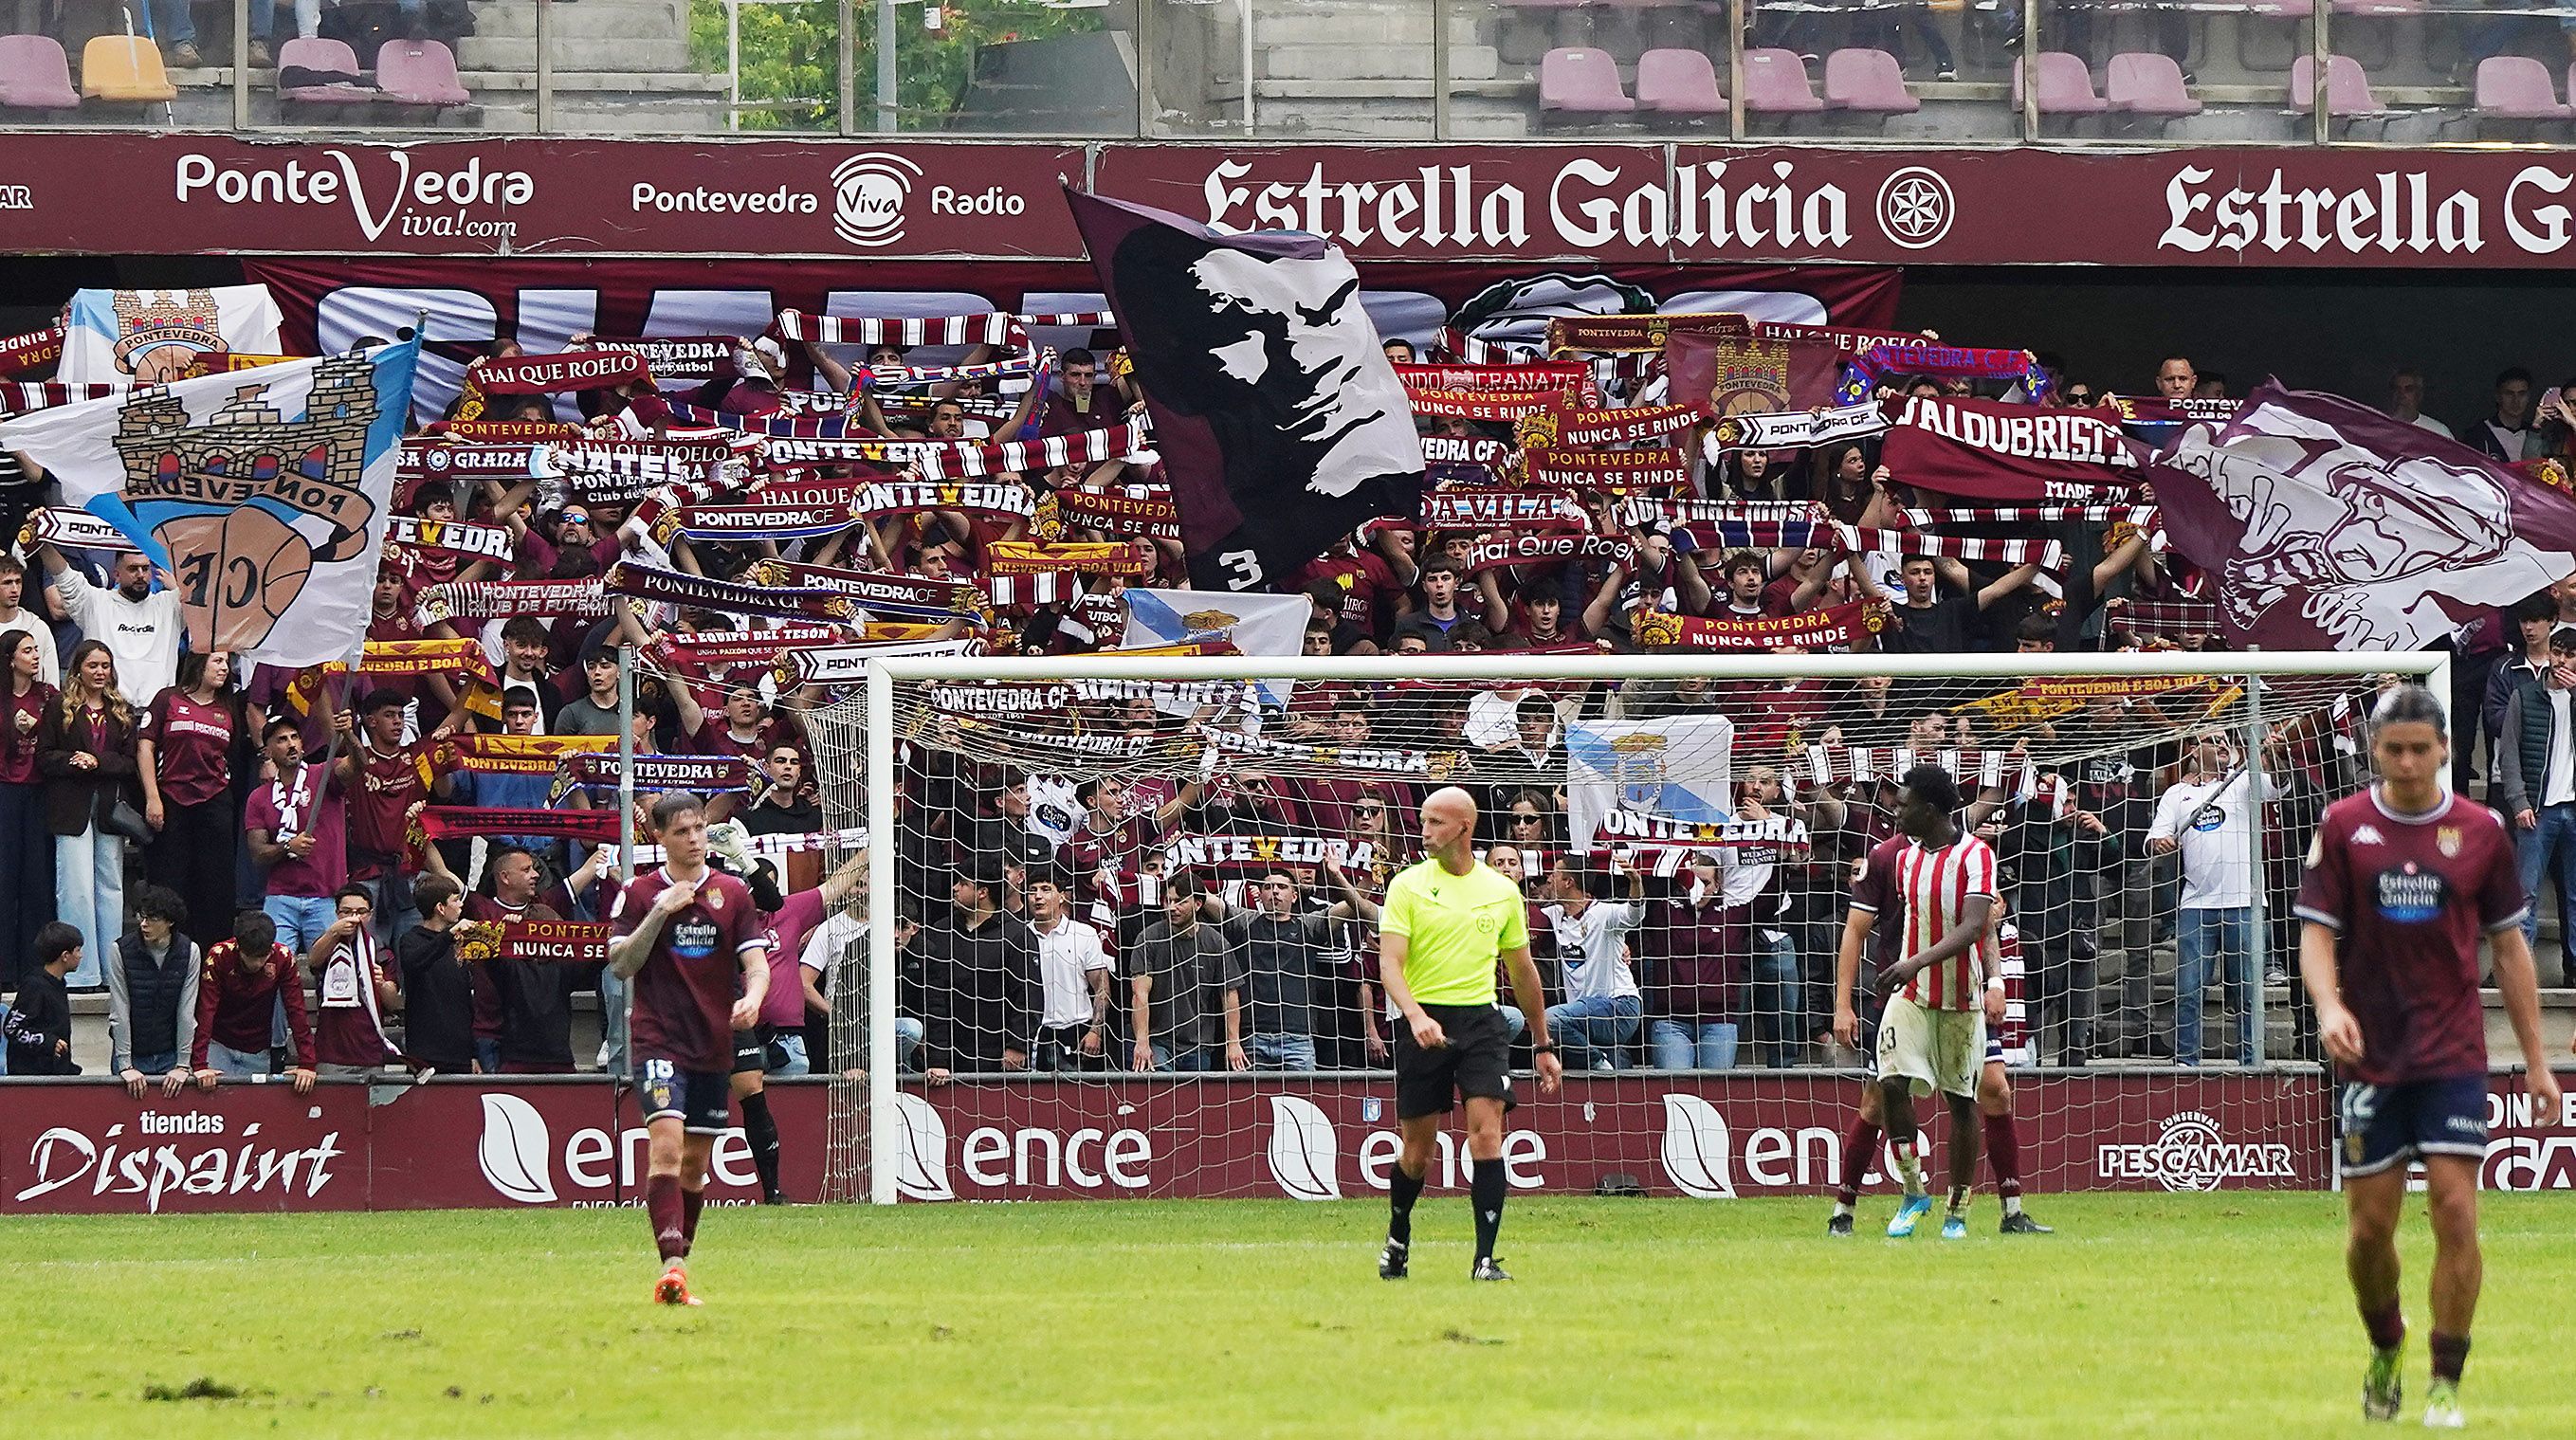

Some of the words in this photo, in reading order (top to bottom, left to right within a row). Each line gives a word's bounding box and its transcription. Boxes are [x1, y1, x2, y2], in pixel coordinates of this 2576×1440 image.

[632, 183, 818, 214] Pontevedra
[841, 185, 903, 215] Viva
[931, 185, 1025, 216] Radio
[1204, 158, 1529, 249] Estrella
[1549, 158, 1854, 249] Galicia
[2156, 163, 2486, 255] Estrella
[125, 328, 219, 351] PONTEVEDRA
[1578, 328, 1644, 337] PONTEVEDRA
[477, 367, 515, 385] HAI
[520, 362, 564, 386] QUE
[569, 355, 639, 379] ROELO
[667, 360, 714, 373] Fútbol
[1718, 380, 1781, 393] PONTEVEDRA
[1409, 399, 1466, 416] NUNCA
[1473, 407, 1492, 418] SE
[450, 423, 569, 437] PONTEVEDRA
[1567, 427, 1622, 446] NUNCA
[1627, 424, 1647, 437] SE
[1653, 410, 1700, 433] RINDE
[1473, 439, 1499, 462] CF
[1548, 451, 1671, 466] PONTEVEDRA
[1538, 469, 1600, 484] NUNCA
[1603, 470, 1624, 484] SE
[1632, 468, 1686, 483] RINDE
[587, 489, 621, 503] Club
[2044, 481, 2093, 501] MADE
[2106, 486, 2130, 502] IN
[1466, 493, 1558, 521] VILA
[1061, 507, 1115, 531] NUNCA
[1122, 520, 1142, 534] SE
[1517, 536, 1573, 556] Que
[643, 574, 776, 608] PONTEVEDRA
[778, 594, 805, 610] CF
[517, 599, 542, 613] DE
[1705, 611, 1831, 631] PONTEVEDRA
[677, 631, 695, 644] EL
[700, 630, 749, 644] EQUIPO
[755, 629, 782, 642] DEL
[785, 627, 830, 640] TESÓN
[1692, 632, 1755, 647] NUNCA
[1763, 635, 1784, 647] SE
[1792, 626, 1848, 646] RINDE
[719, 647, 747, 656] PAIXÓN
[430, 657, 464, 669] BOA
[462, 755, 557, 773] PONTEVEDRA
[599, 759, 714, 779] POTEVEDRA
[674, 923, 717, 937] Estrella
[513, 941, 575, 958] NUNCA
[583, 943, 605, 958] SE
[676, 935, 715, 947] Galicia
[140, 1109, 225, 1135] tiendas
[2158, 1111, 2221, 1132] CONSERVAS
[962, 1125, 1154, 1188] ence
[2099, 1143, 2296, 1177] PESCAMAR
[14, 1122, 346, 1215] Dispaint
